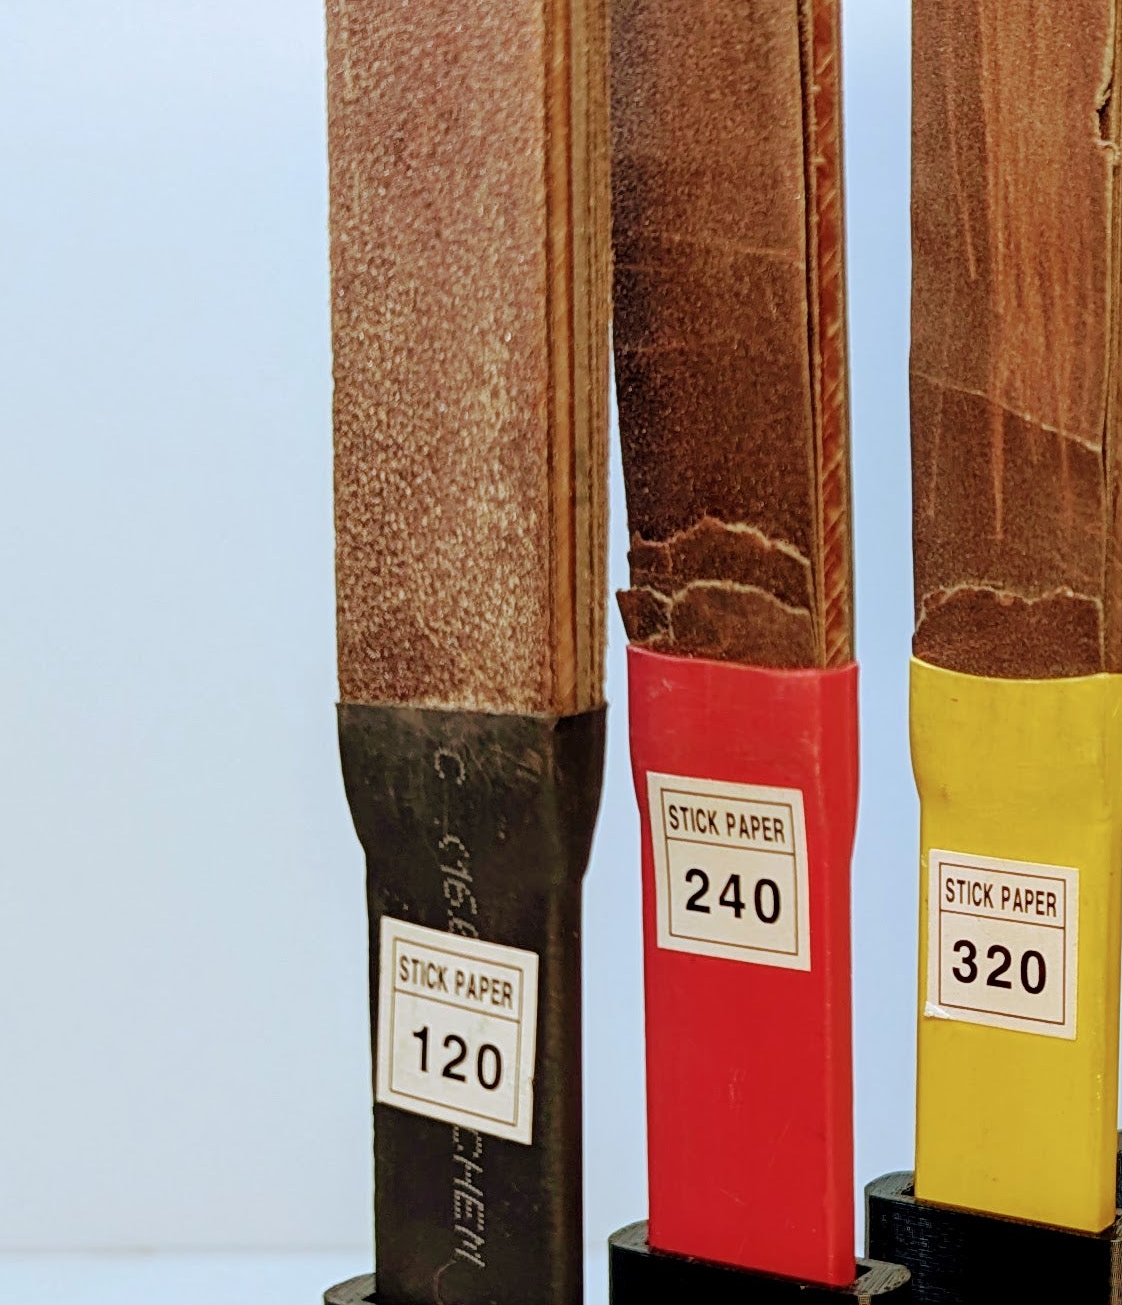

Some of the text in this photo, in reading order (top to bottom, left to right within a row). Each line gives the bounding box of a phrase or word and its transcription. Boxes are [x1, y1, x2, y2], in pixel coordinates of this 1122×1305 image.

[669, 804, 785, 844] STICK PAPER
[685, 868, 780, 924] 240
[945, 877, 1057, 918] STICK PAPER
[400, 955, 513, 1010] STICK PAPER
[952, 939, 1047, 995] 320
[413, 1025, 502, 1091] 120
